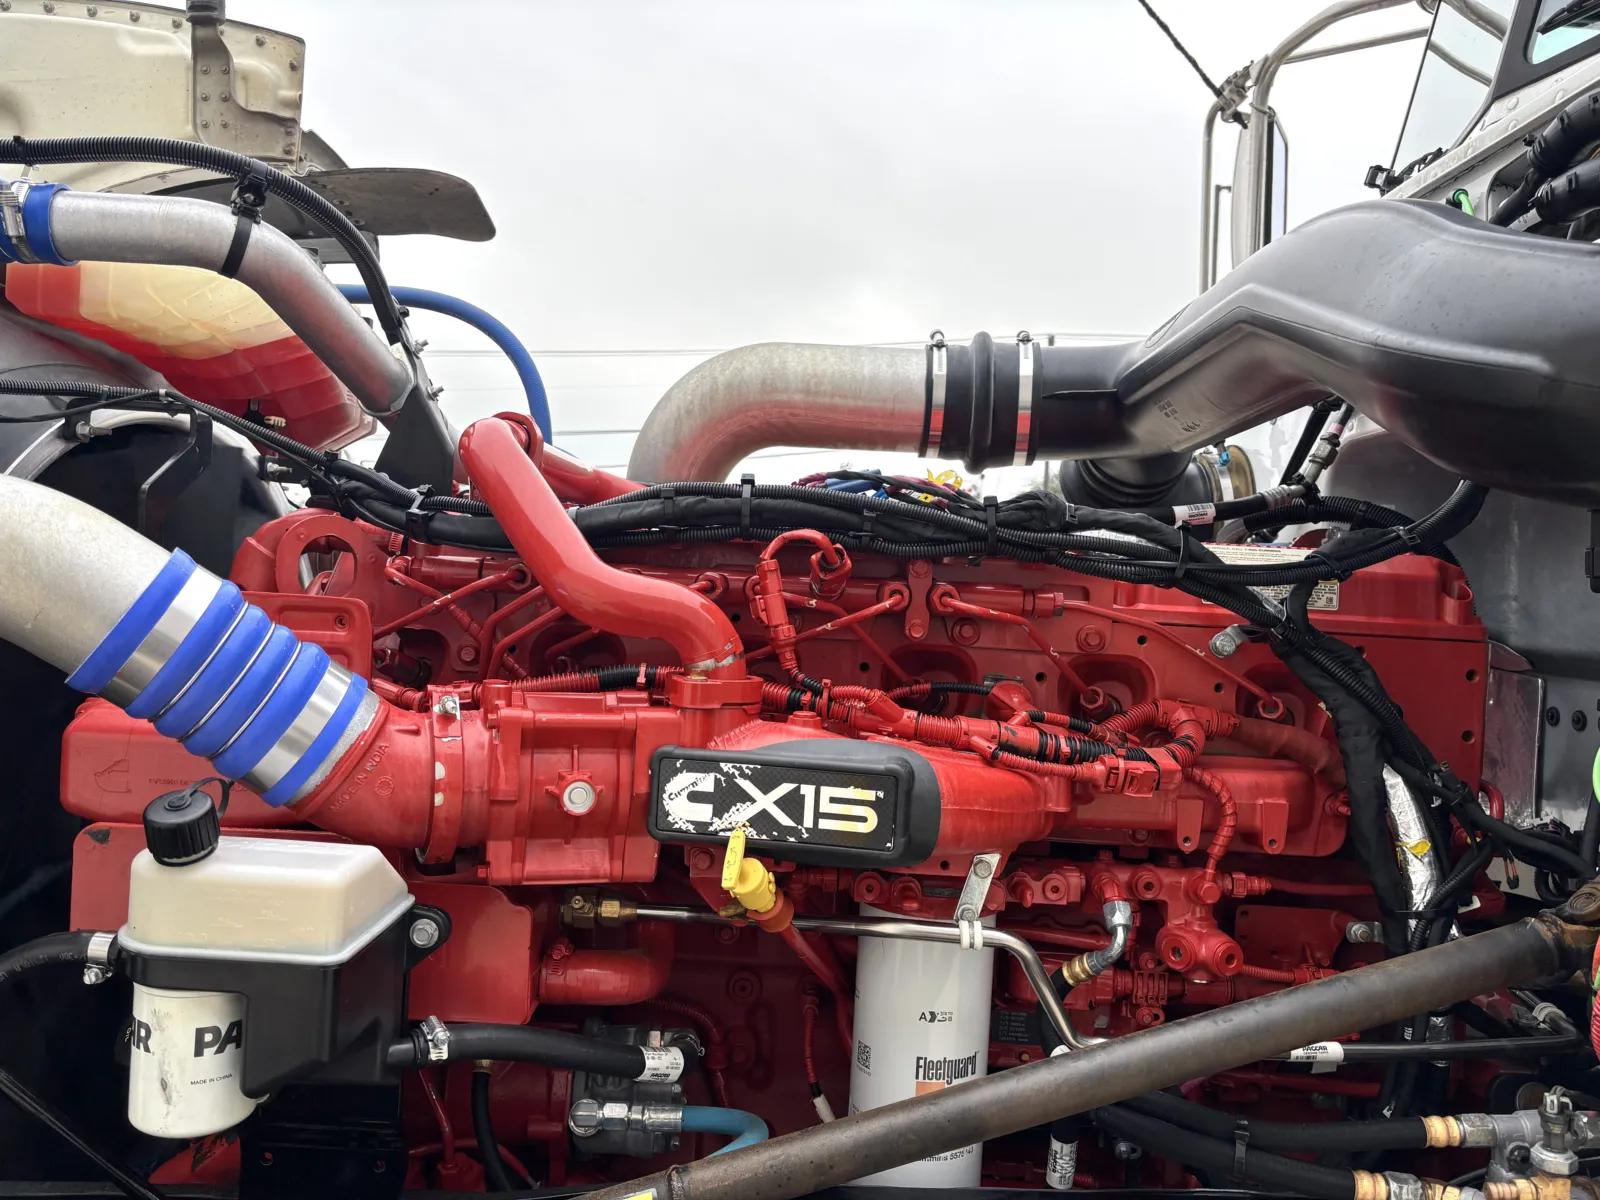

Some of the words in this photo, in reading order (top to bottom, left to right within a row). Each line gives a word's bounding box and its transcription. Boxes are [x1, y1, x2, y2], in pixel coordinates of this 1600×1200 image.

[355, 771, 367, 786] IN
[365, 744, 391, 774] INDIA
[216, 1073, 233, 1082] CHINA
[915, 1051, 977, 1086] Fleetguard
